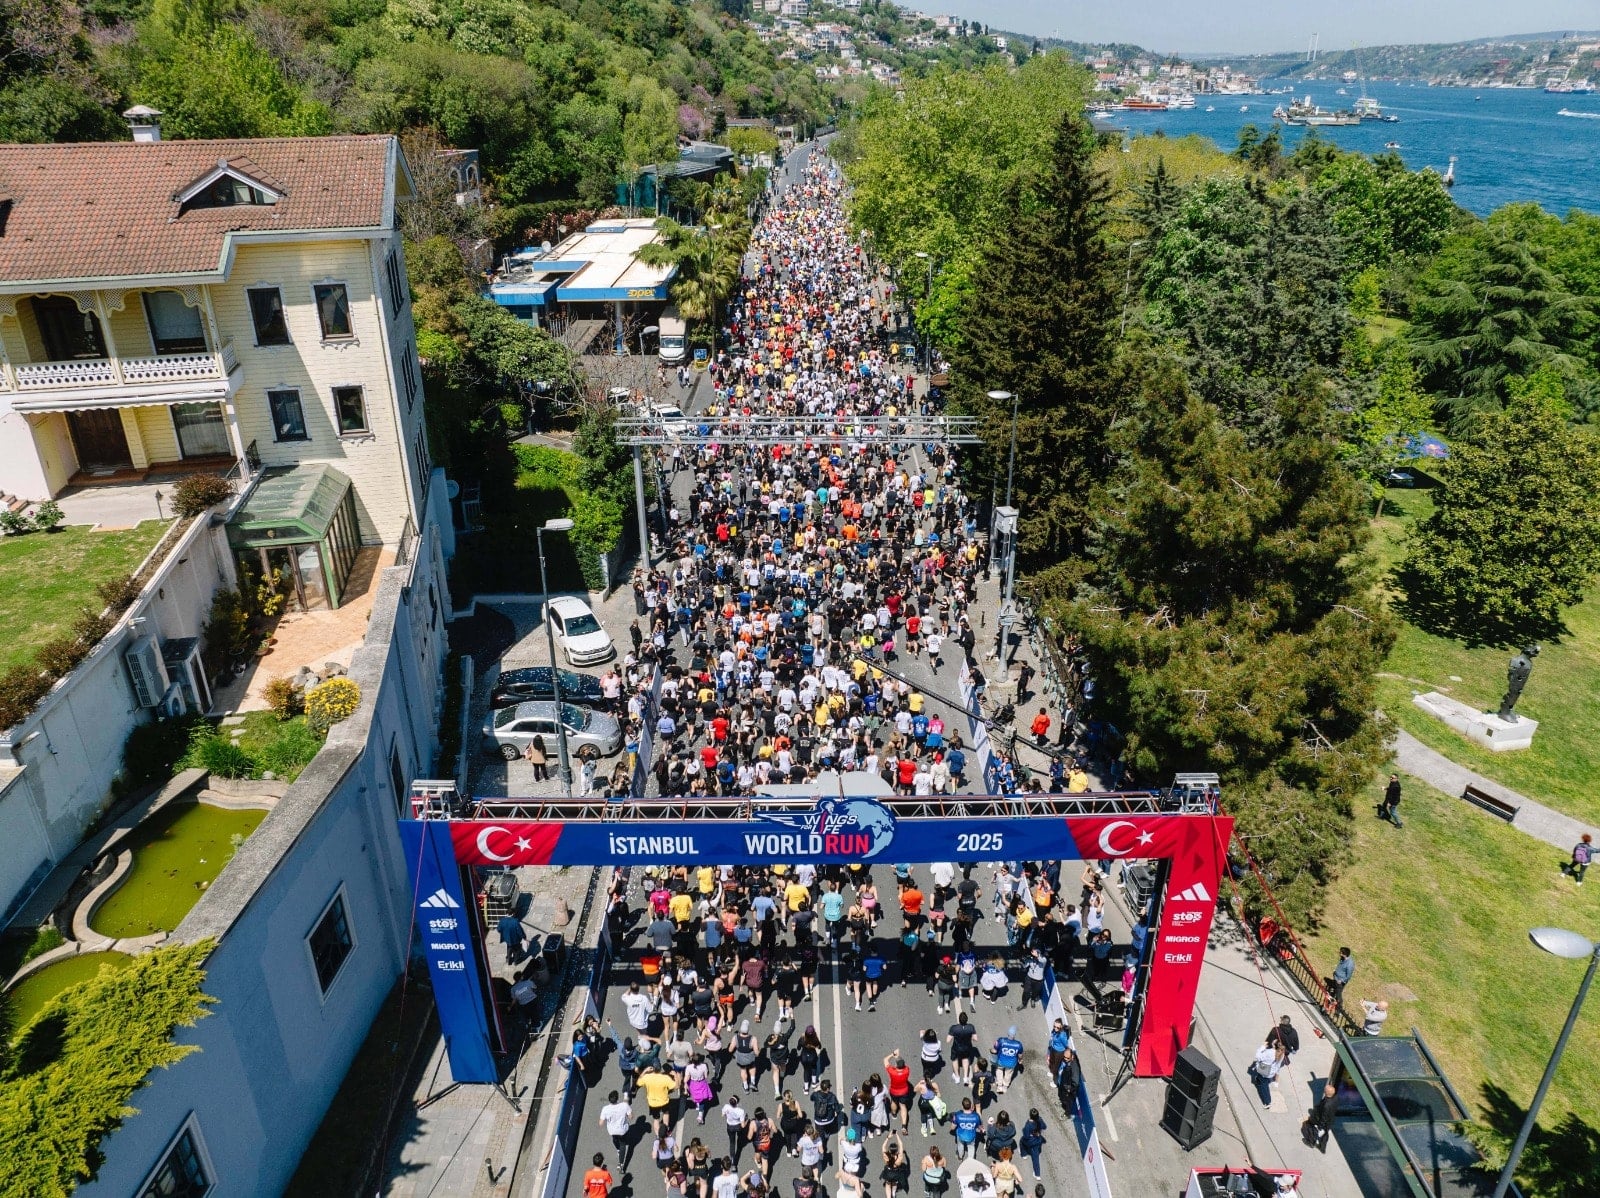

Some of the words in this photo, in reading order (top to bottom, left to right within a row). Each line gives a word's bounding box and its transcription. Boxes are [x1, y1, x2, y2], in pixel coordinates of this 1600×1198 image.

[803, 815, 858, 825] WINGS
[810, 824, 843, 835] LIFE
[609, 832, 699, 855] İSTANBUL
[744, 834, 823, 855] WORLD
[825, 834, 870, 855] RUN
[956, 833, 1003, 852] 2025
